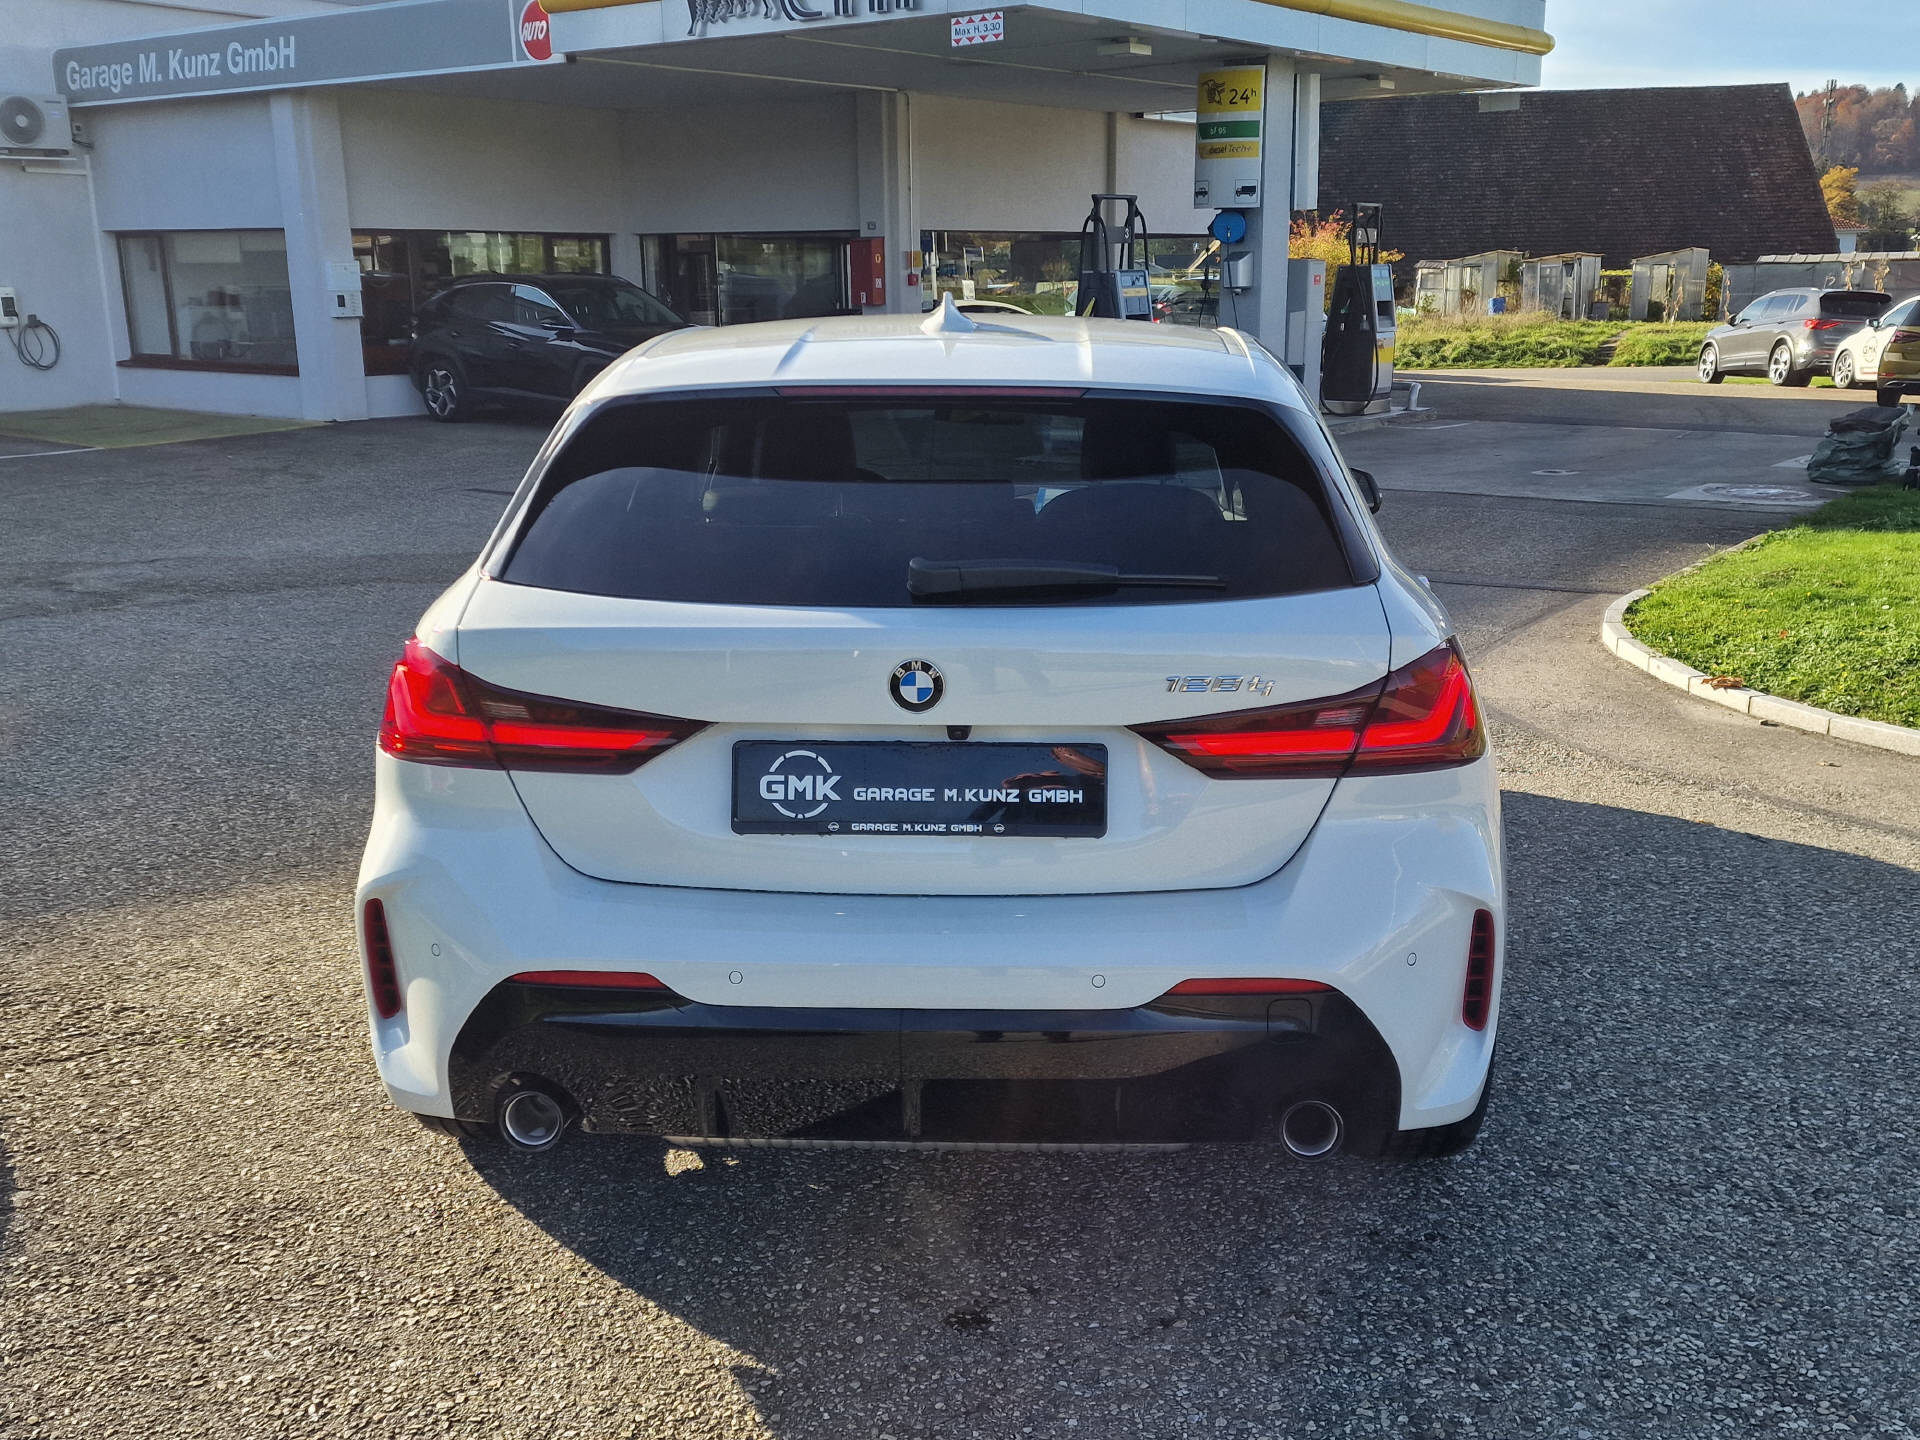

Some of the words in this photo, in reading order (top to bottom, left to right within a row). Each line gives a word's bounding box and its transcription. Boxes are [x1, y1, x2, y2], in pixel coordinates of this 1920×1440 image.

[522, 20, 547, 42] AUTO
[955, 28, 970, 36] Max
[984, 22, 1000, 32] 3.30
[66, 61, 133, 93] Garage
[138, 52, 163, 83] M.
[168, 49, 221, 80] Kunz
[226, 35, 295, 74] GmbH
[1124, 227, 1131, 239] 3
[895, 661, 940, 679] BMW
[759, 775, 843, 801] GMK
[853, 788, 935, 801] GARAGE
[944, 789, 1020, 803] M.KUNZ
[1028, 790, 1083, 803] GMBH
[851, 823, 898, 832] GARAGE
[902, 823, 947, 832] M.KUNZ
[950, 824, 982, 833] GMBH
